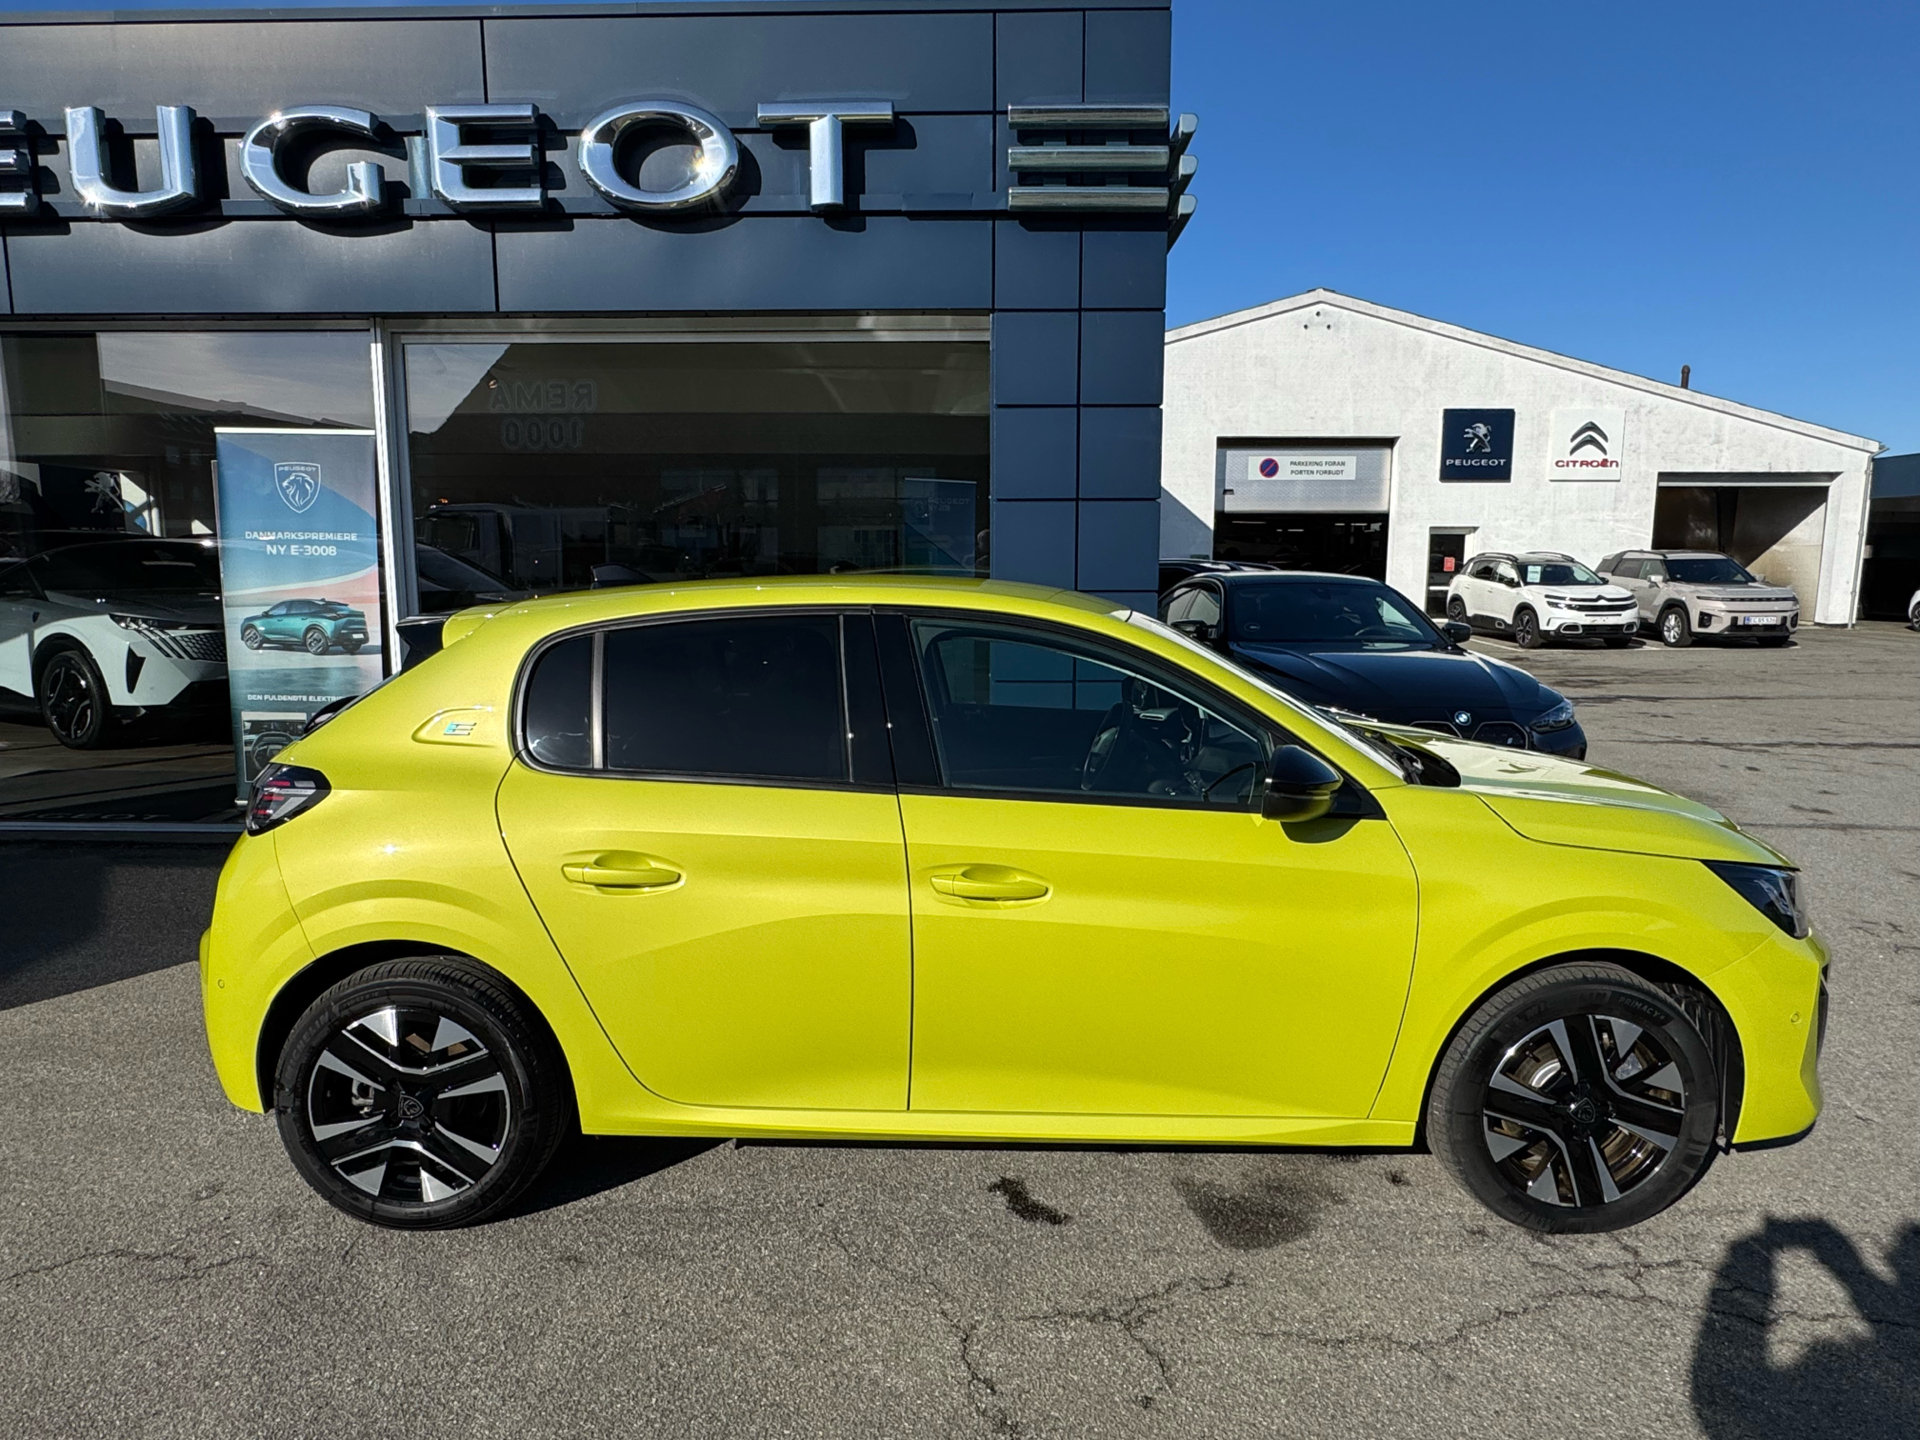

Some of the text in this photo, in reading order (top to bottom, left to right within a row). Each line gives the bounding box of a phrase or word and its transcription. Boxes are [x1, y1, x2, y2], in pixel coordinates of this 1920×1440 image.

[1446, 459, 1506, 467] PEUGEOT
[245, 531, 357, 541] DANMARKSPREMIERE
[266, 545, 337, 556] NY E-3008
[264, 694, 307, 702] FULDENDTE
